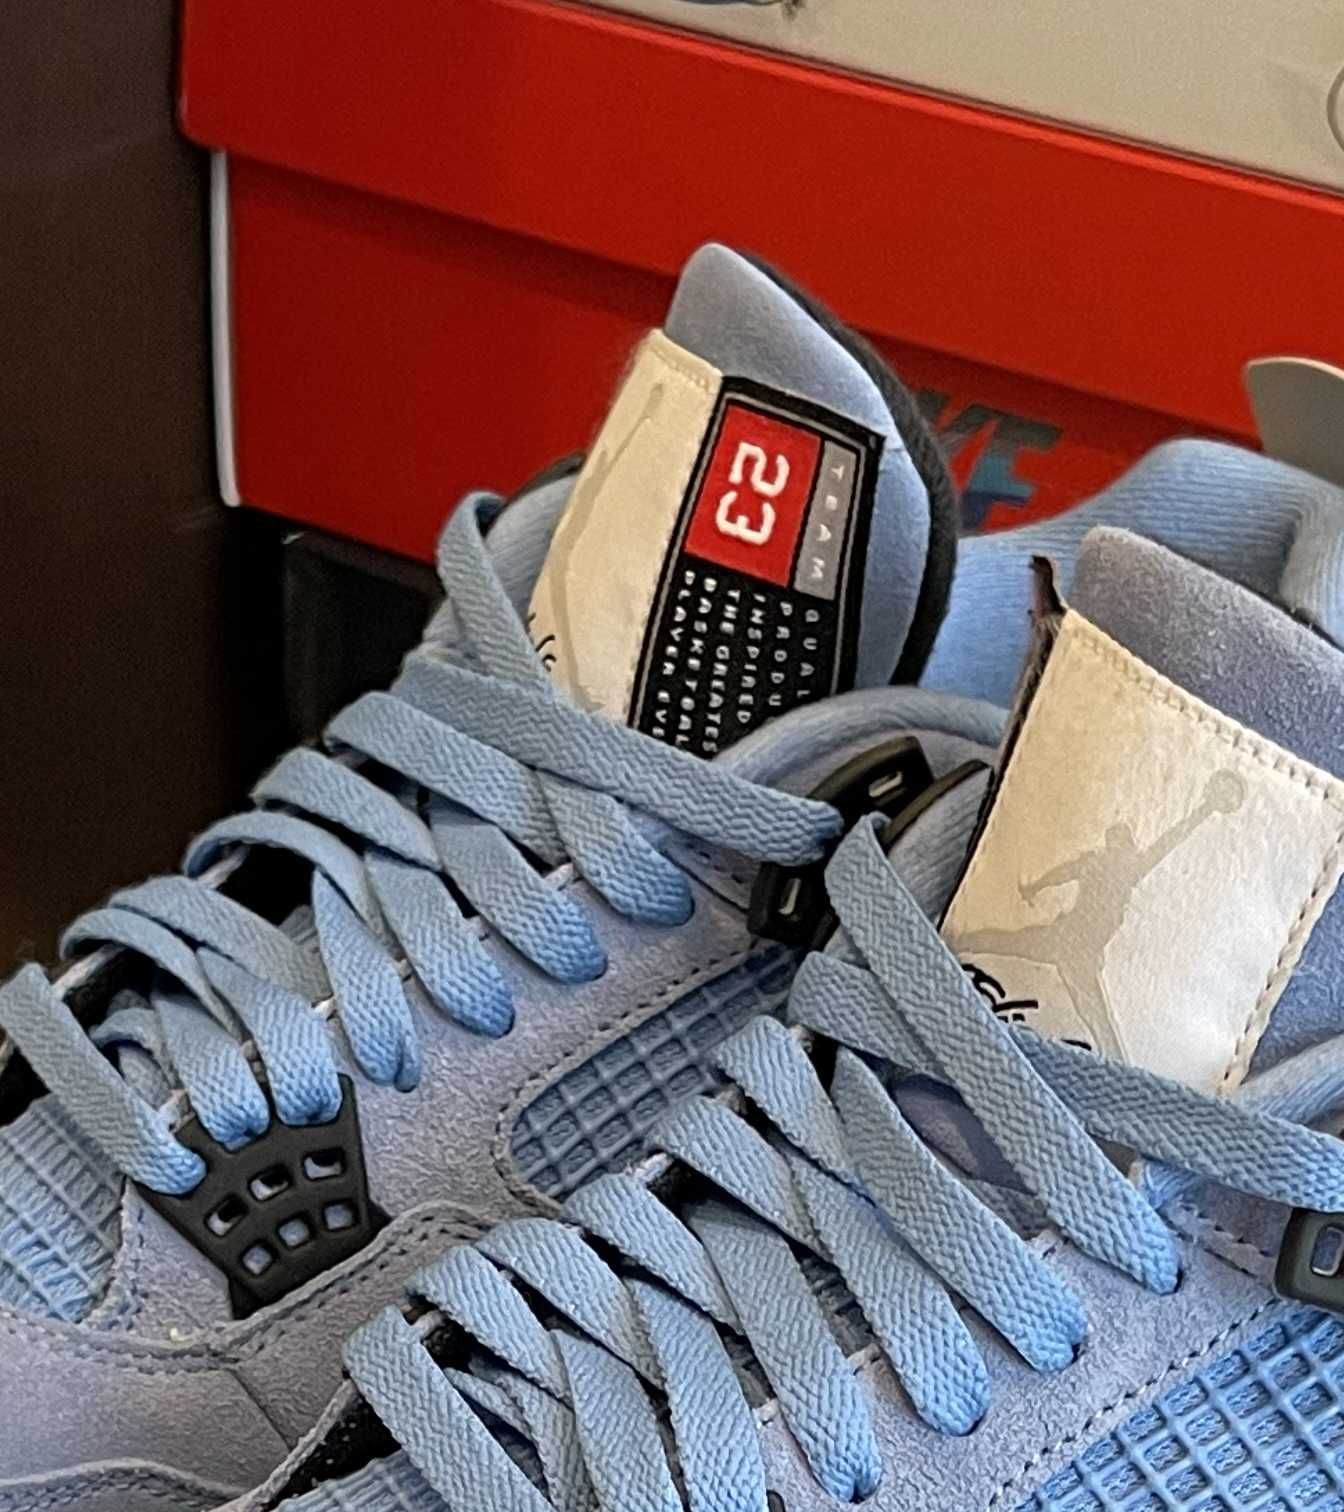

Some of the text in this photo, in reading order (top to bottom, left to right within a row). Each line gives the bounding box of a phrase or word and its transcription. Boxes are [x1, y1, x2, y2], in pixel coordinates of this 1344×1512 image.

[714, 441, 790, 546] 23
[811, 464, 845, 579] TEAM
[652, 570, 696, 737] PLAYER EVE
[675, 577, 717, 745] BASKETBAL
[702, 589, 741, 753] THE GREATES
[736, 593, 766, 724] INSPIRED
[769, 601, 793, 706] PRODU
[797, 608, 820, 698] QUAL
